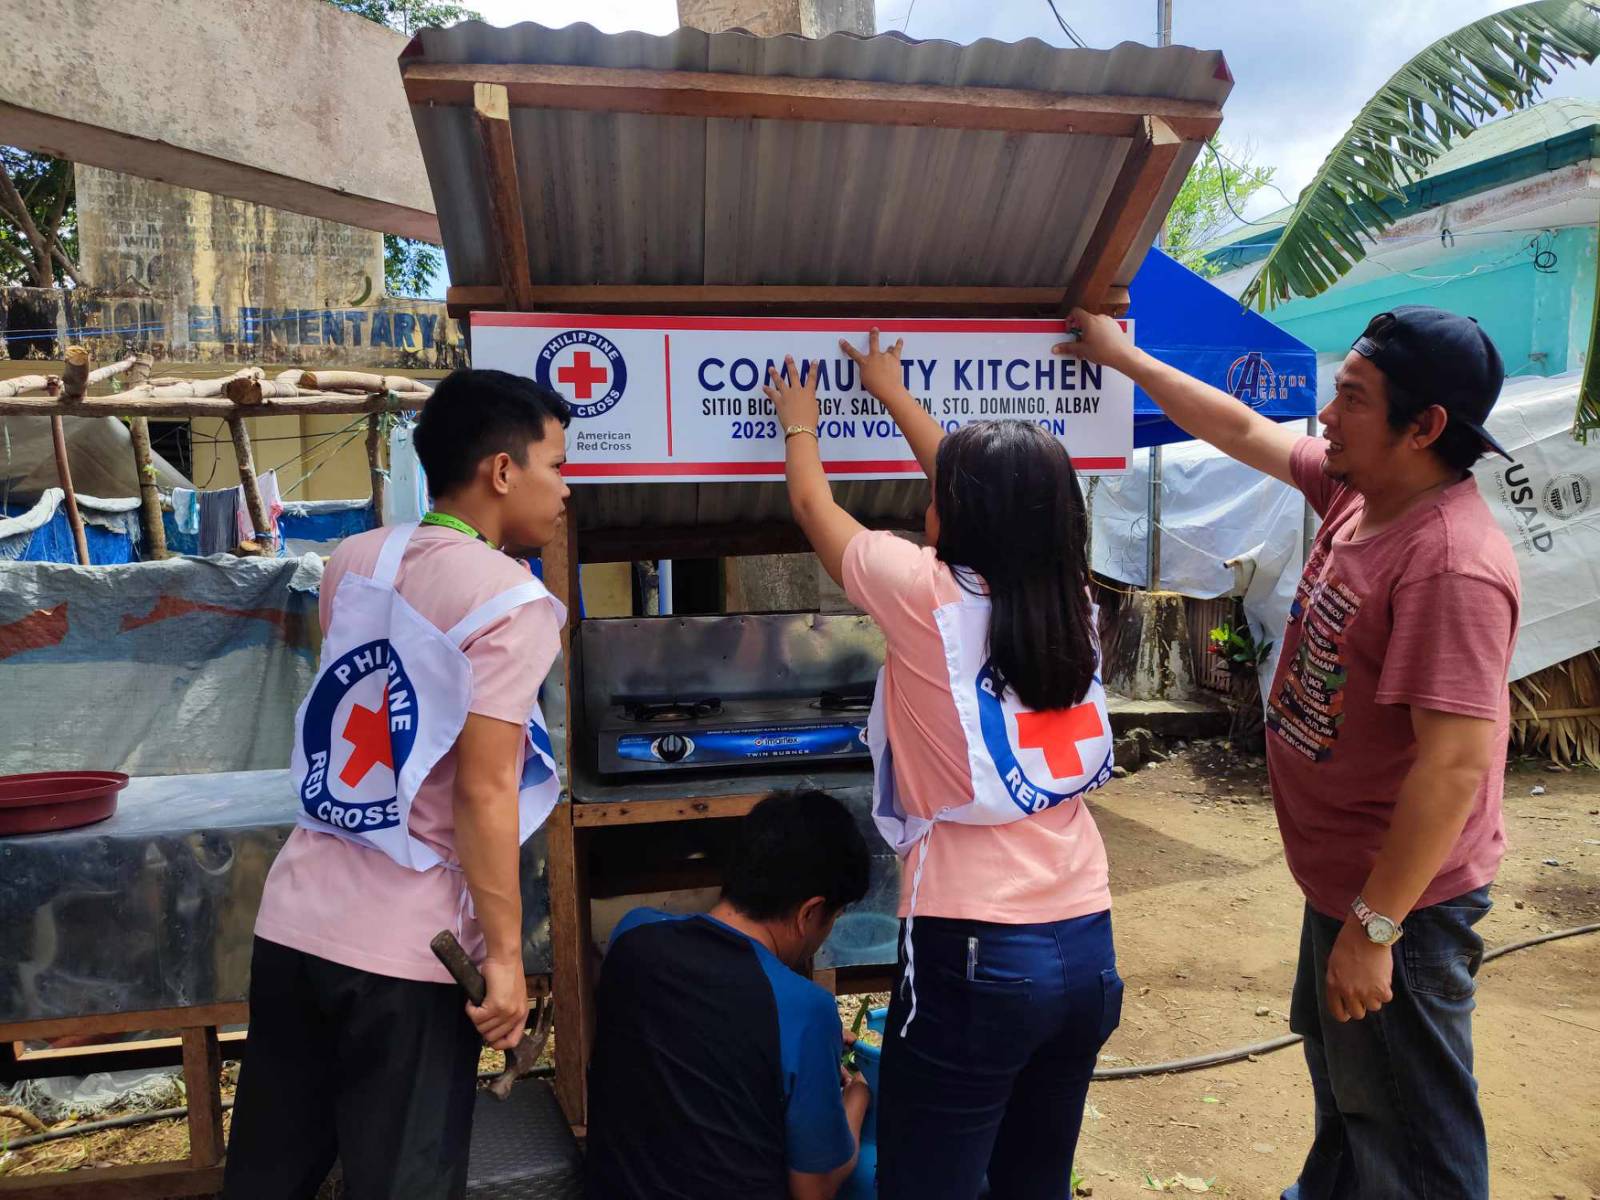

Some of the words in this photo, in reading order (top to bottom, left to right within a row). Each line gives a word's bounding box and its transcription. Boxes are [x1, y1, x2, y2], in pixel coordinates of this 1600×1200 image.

[188, 305, 437, 349] ELEMENTARY
[543, 332, 620, 361] PHILIPPINE
[698, 357, 937, 392] COMMUTY
[954, 358, 1102, 391] KITCHEN
[577, 388, 620, 417] CROSS
[702, 398, 742, 416] SITIO
[748, 398, 777, 416] BIC
[816, 398, 845, 416] RGY.
[943, 397, 974, 415] STO.
[980, 397, 1050, 416] DOMINGO,
[1055, 397, 1100, 413] ALBAY
[577, 431, 631, 441] American
[731, 421, 776, 439] 2023
[862, 420, 959, 438] VOLO
[577, 442, 598, 451] Red
[600, 442, 632, 451] Cross
[1505, 463, 1553, 552] USAID
[334, 646, 411, 732] PHIPINE
[305, 750, 327, 800] RED
[317, 801, 401, 828] CROSS
[1006, 766, 1050, 812] RED
